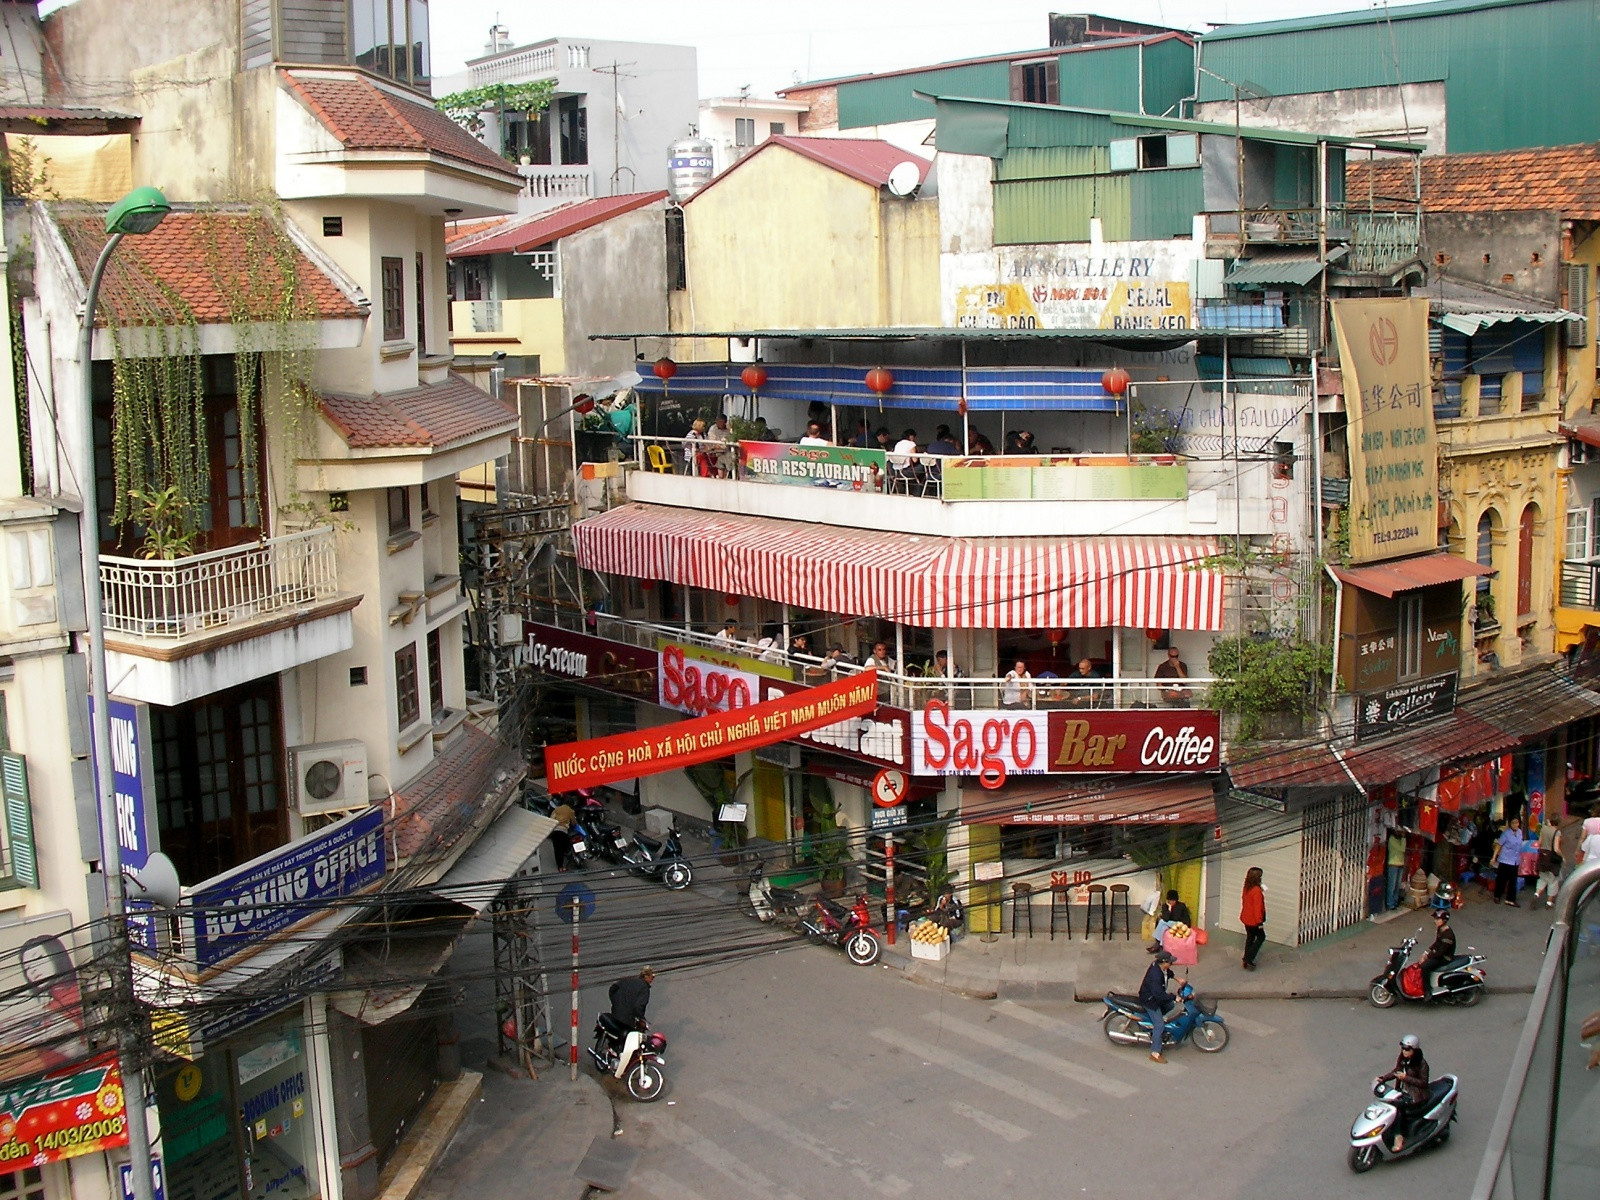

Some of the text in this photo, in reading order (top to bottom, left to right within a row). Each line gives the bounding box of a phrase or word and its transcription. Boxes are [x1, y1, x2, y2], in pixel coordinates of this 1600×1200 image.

[1054, 257, 1154, 278] GALLERY
[753, 458, 871, 482] BAR RESTAURANT
[789, 446, 829, 461] Sago
[1387, 691, 1436, 722] Gallery
[553, 752, 586, 780] NƯỚC
[590, 750, 624, 772] CỘNG
[628, 740, 652, 764] HOÀ
[676, 733, 697, 755] HỘI
[699, 722, 723, 749] CHỦ
[763, 711, 788, 732] VIỆT
[791, 708, 815, 724] NAM
[817, 694, 846, 717] MUÔN
[923, 698, 1037, 789] Sago
[1055, 720, 1215, 767] Bar Coffee
[296, 849, 313, 861] TRONG
[205, 866, 309, 943] BOOKING
[314, 832, 378, 888] OFFICE
[244, 1072, 305, 1122] BOOKING OFFICE
[0, 1117, 123, 1161] đến 14/03/2008
